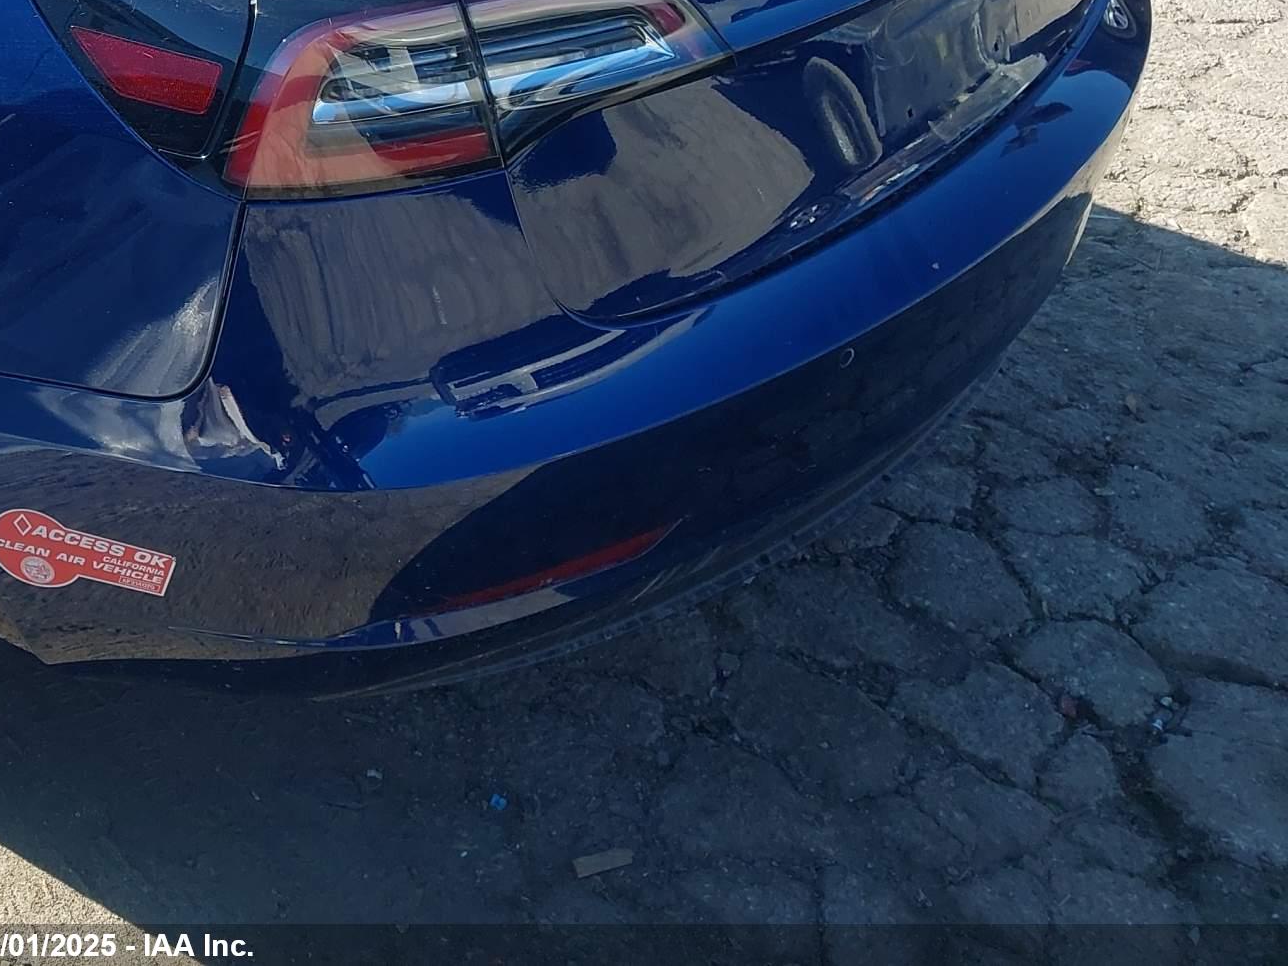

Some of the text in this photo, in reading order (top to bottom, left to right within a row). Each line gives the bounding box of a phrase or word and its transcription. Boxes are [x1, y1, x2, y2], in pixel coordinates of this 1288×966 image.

[32, 525, 170, 569] ACCESS OK
[56, 552, 86, 566] AIR
[92, 561, 164, 584] VEHICLE
[103, 556, 165, 577] CALIFORNIA
